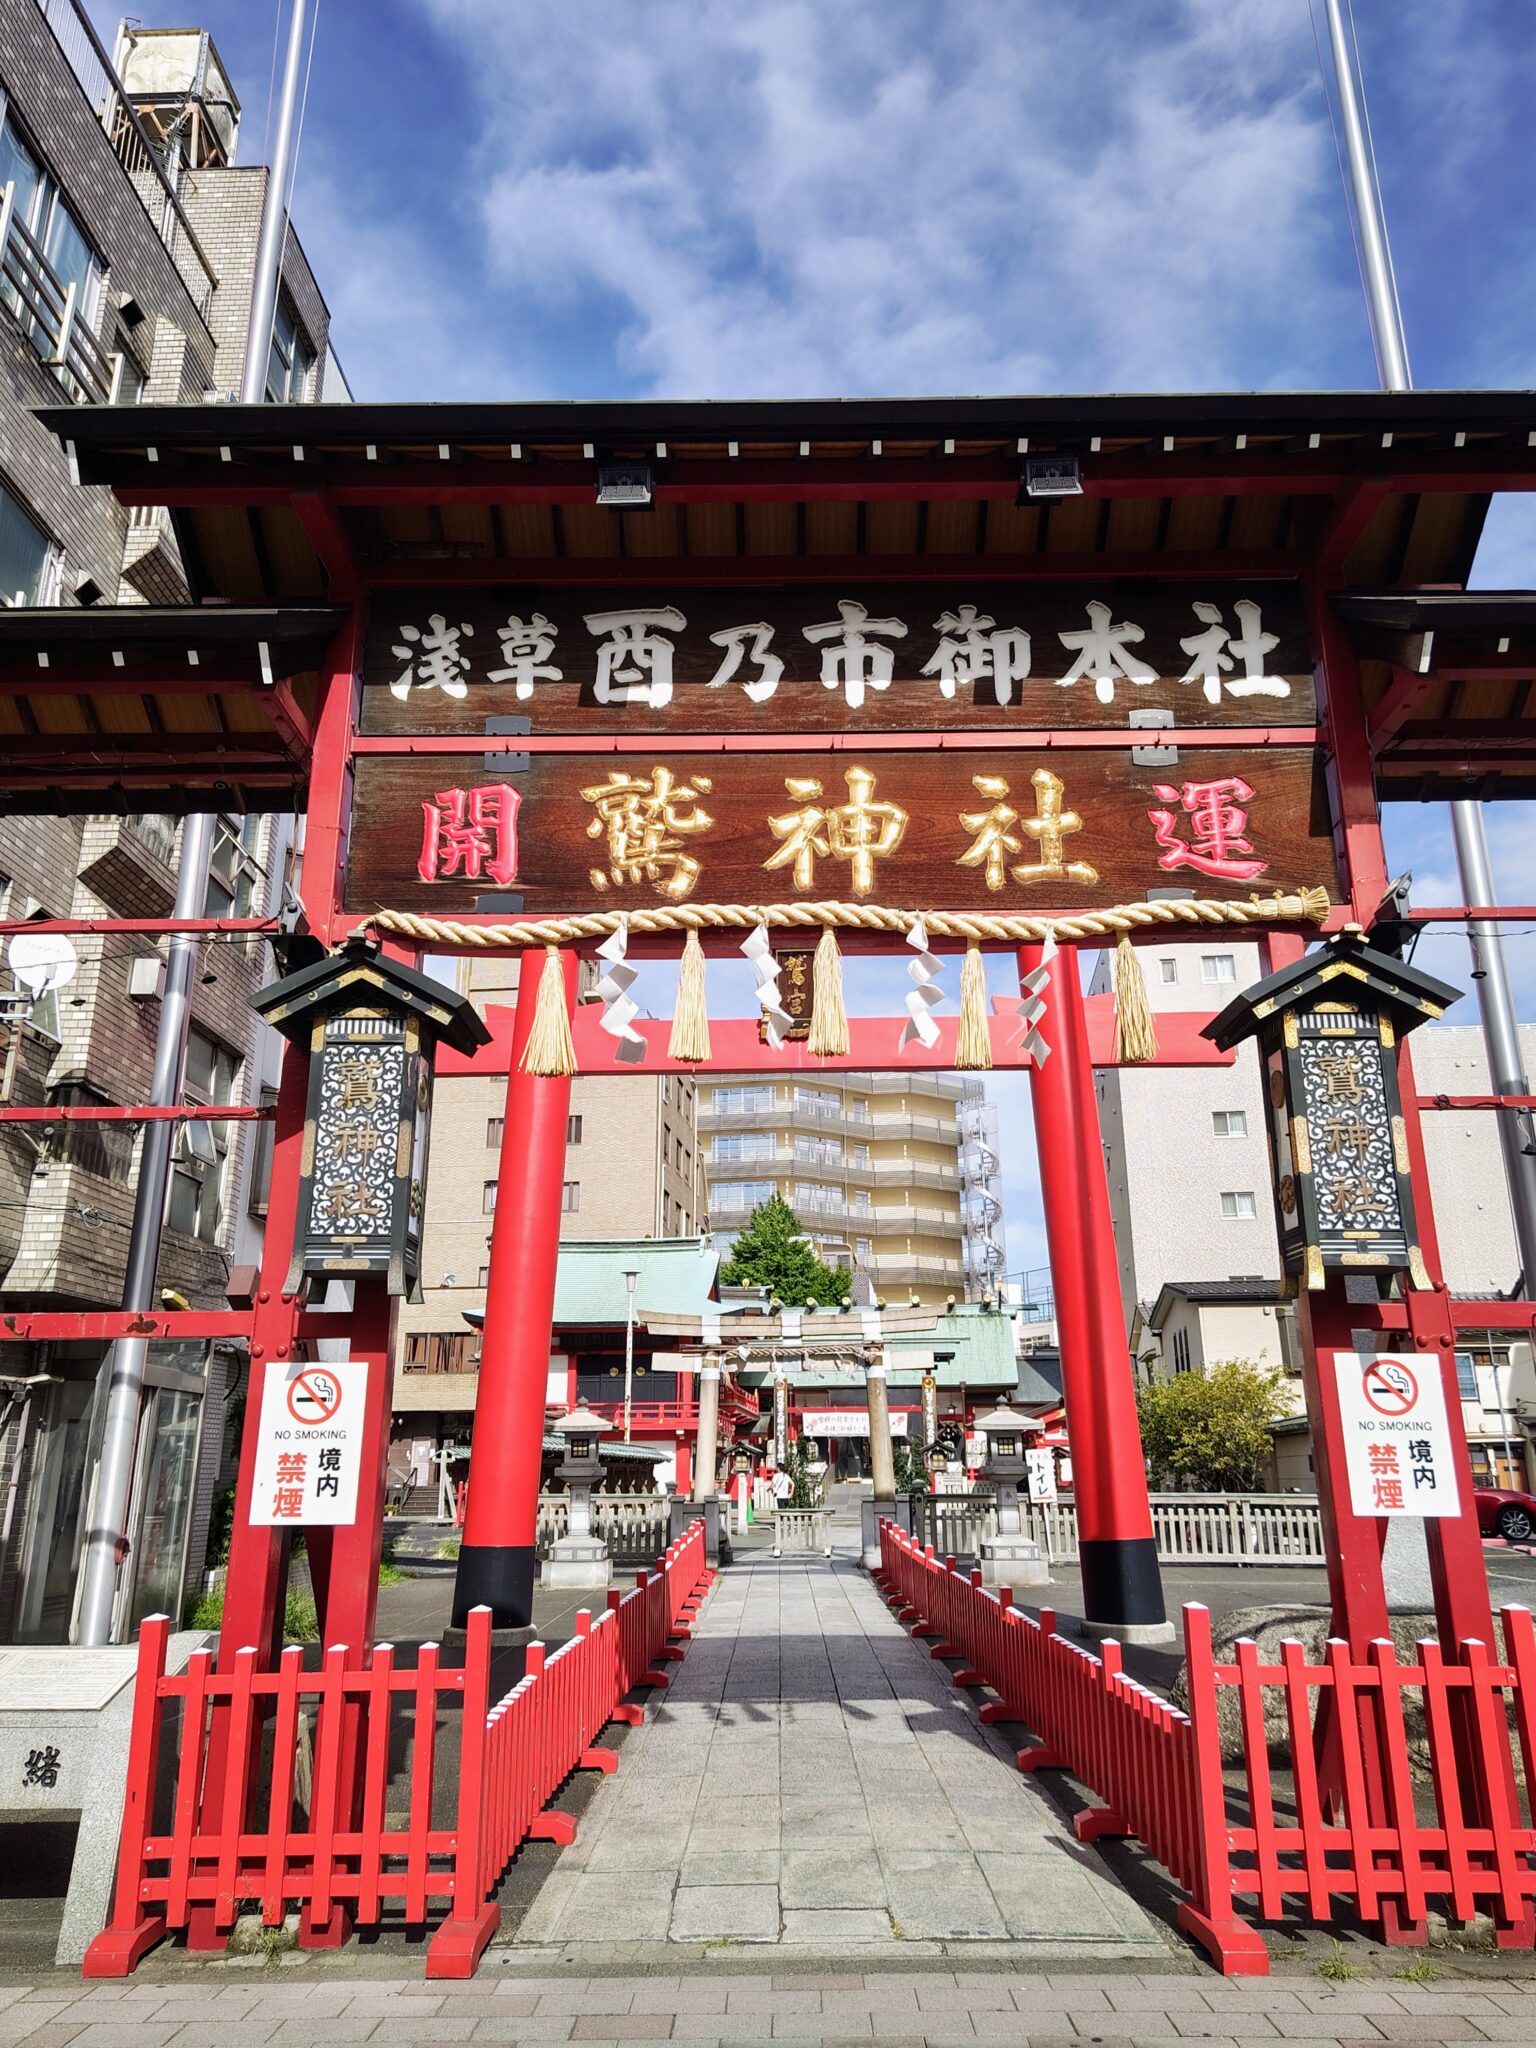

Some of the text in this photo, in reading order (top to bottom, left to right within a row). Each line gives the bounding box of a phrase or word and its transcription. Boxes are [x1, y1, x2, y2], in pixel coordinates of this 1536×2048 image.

[418, 766, 1270, 898] 開 鷲神社 運
[325, 1058, 383, 1218] 鷲神社
[1315, 1051, 1388, 1215] 鷲神社
[274, 1430, 347, 1440] NO SMOKING
[1358, 1421, 1433, 1431] NO SMOKING
[271, 1452, 307, 1518] 禁煙
[316, 1447, 342, 1498] 境内
[1036, 1462, 1049, 1496] トイレ
[1367, 1443, 1405, 1509] 禁煙
[1408, 1439, 1436, 1489] 境内
[22, 1745, 61, 1788] 緒
